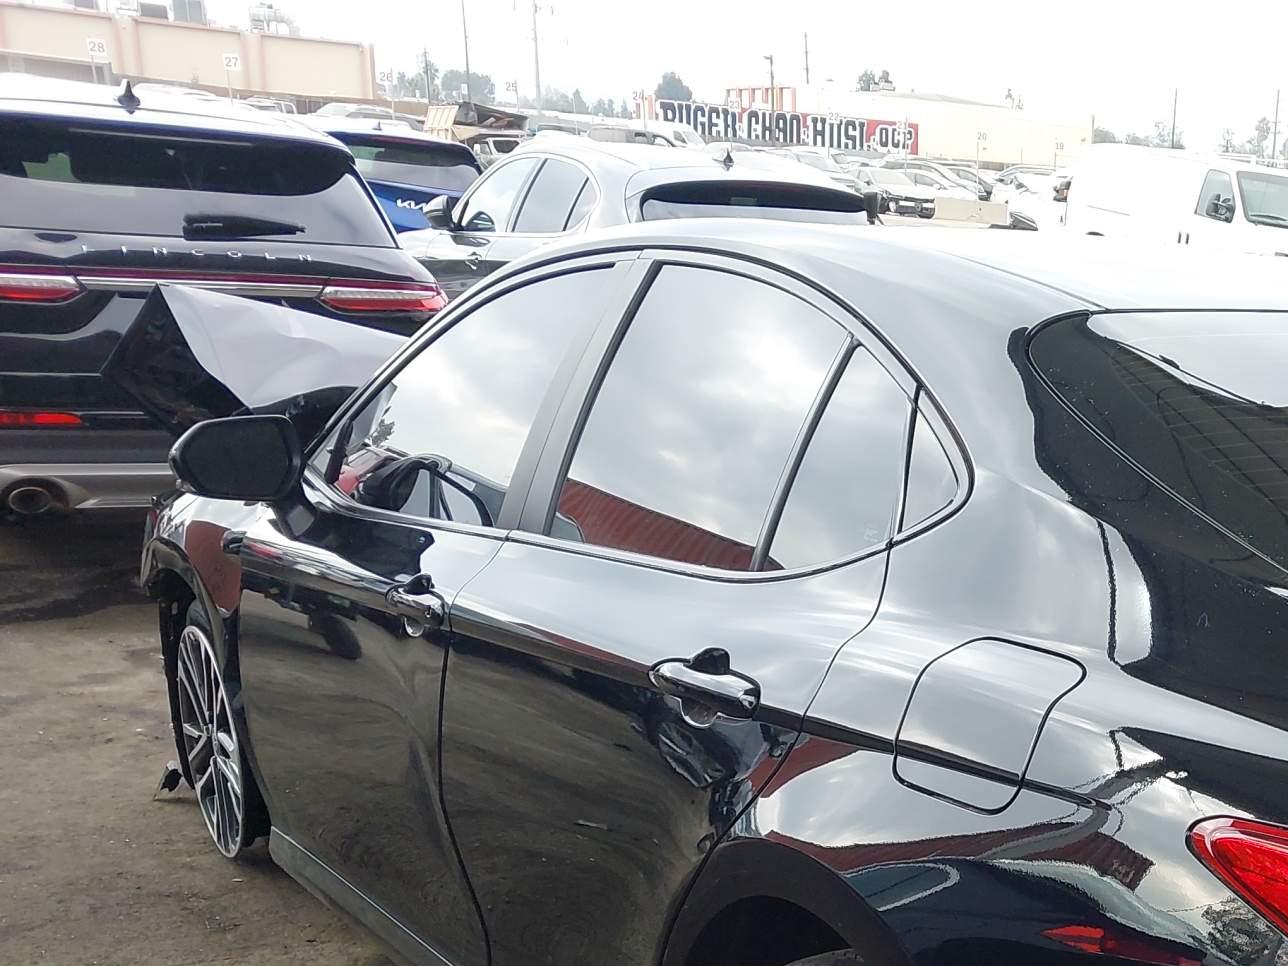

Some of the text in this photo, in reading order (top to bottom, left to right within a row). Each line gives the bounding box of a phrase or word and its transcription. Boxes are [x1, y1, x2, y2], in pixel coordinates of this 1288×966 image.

[88, 41, 105, 53] 28
[224, 56, 239, 67] 27
[505, 81, 517, 92] 25
[81, 244, 312, 263] LINCOLN
